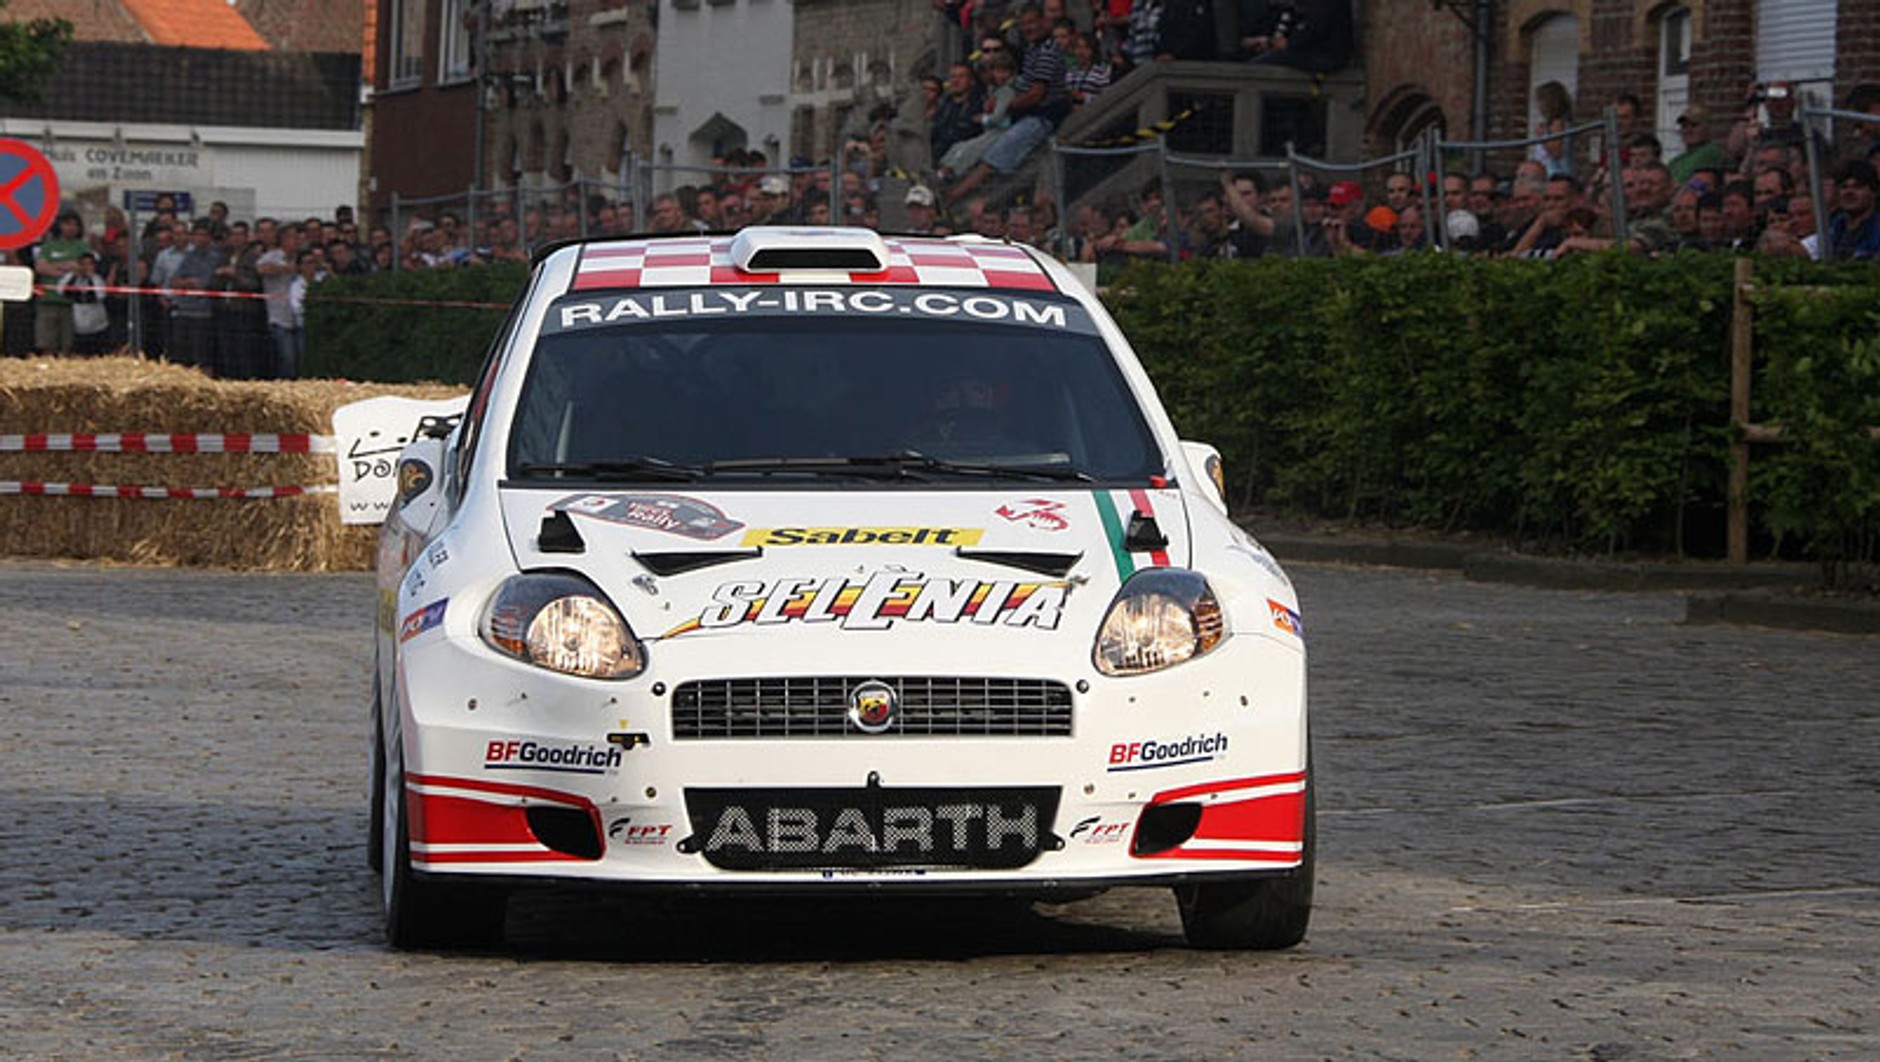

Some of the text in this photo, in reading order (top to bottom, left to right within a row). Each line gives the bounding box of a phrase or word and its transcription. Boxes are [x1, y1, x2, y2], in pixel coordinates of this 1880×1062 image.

[560, 290, 1067, 328] RALLY-IRC.COM
[764, 528, 960, 545] Sabelt
[486, 740, 623, 768] BFGoodrich
[1109, 732, 1229, 765] BFGoodrich
[626, 824, 673, 836] FPT
[704, 803, 1039, 853] ABARTH
[1091, 822, 1130, 836] FPT
